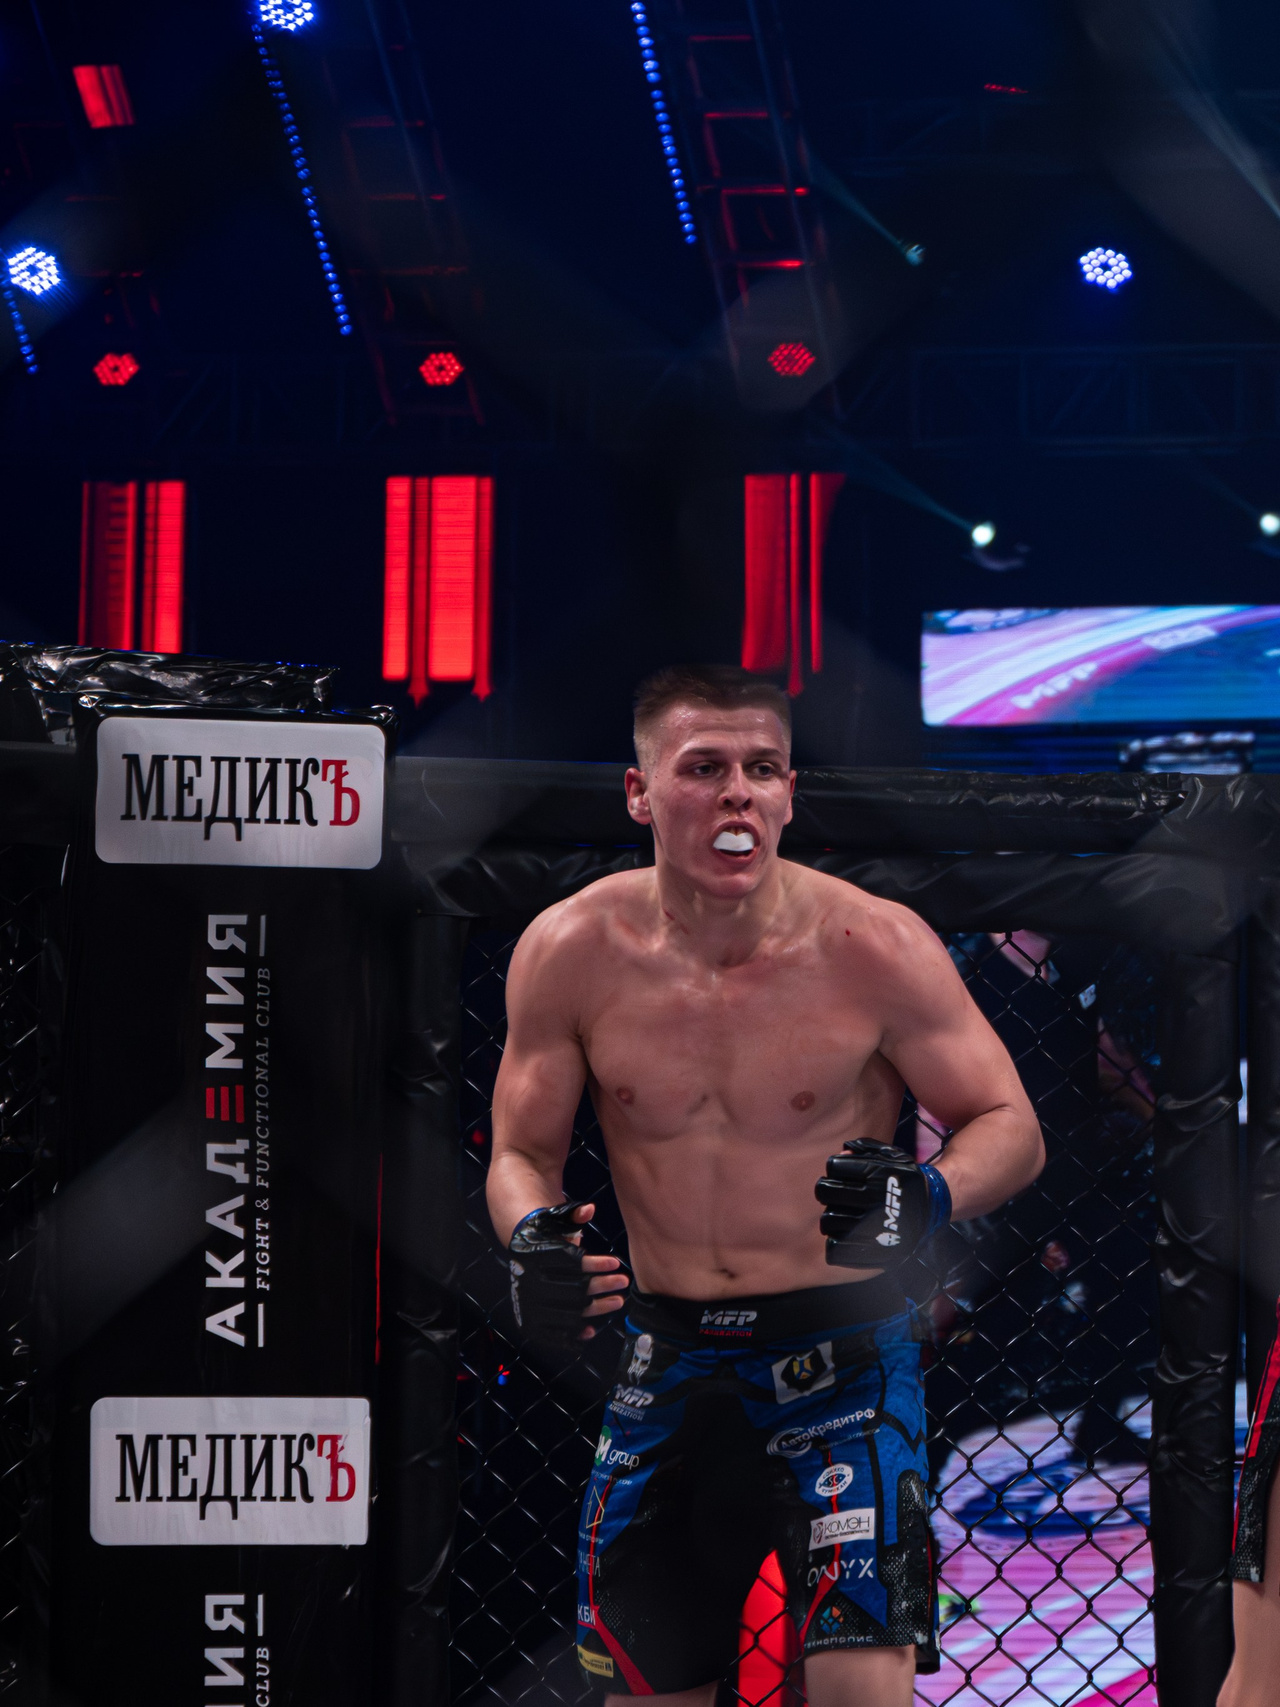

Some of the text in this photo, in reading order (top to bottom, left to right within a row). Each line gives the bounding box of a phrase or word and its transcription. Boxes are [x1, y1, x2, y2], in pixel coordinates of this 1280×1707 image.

[120, 754, 361, 841] МЕДИКЪ
[205, 914, 249, 1347] АКАДЕМИЯ
[254, 967, 271, 1291] FIGHT & FUNCTIONAL CLUB
[883, 1175, 903, 1231] MFP
[700, 1309, 758, 1326] MFP
[614, 1384, 654, 1408] MFP
[115, 1434, 356, 1520] МЕДИКЪ
[608, 1449, 640, 1470] group
[824, 1516, 870, 1535] КОМЭН
[807, 1557, 874, 1587] ONYX
[203, 1593, 246, 1707] ИЯ
[255, 1646, 271, 1707] CLUB
